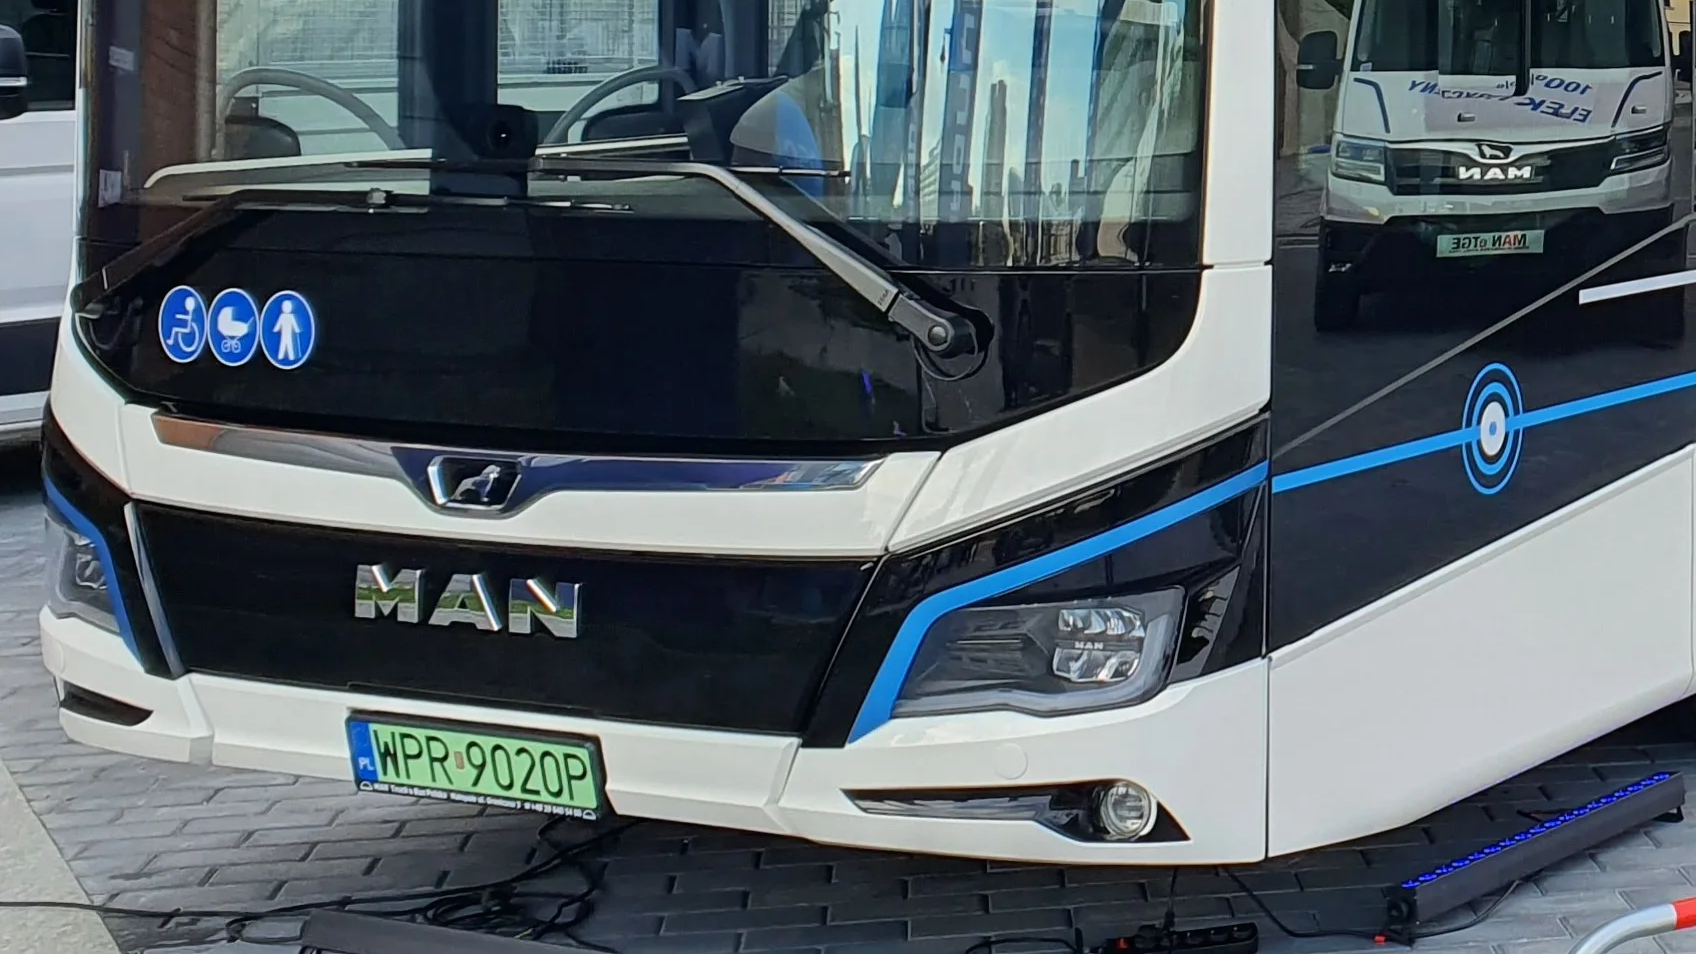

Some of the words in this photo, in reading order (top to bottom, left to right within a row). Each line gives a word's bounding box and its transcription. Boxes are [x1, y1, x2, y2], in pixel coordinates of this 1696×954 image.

[355, 562, 583, 638] MAN
[359, 757, 374, 772] PL
[373, 729, 453, 785] WPR
[465, 740, 587, 801] 9020P
